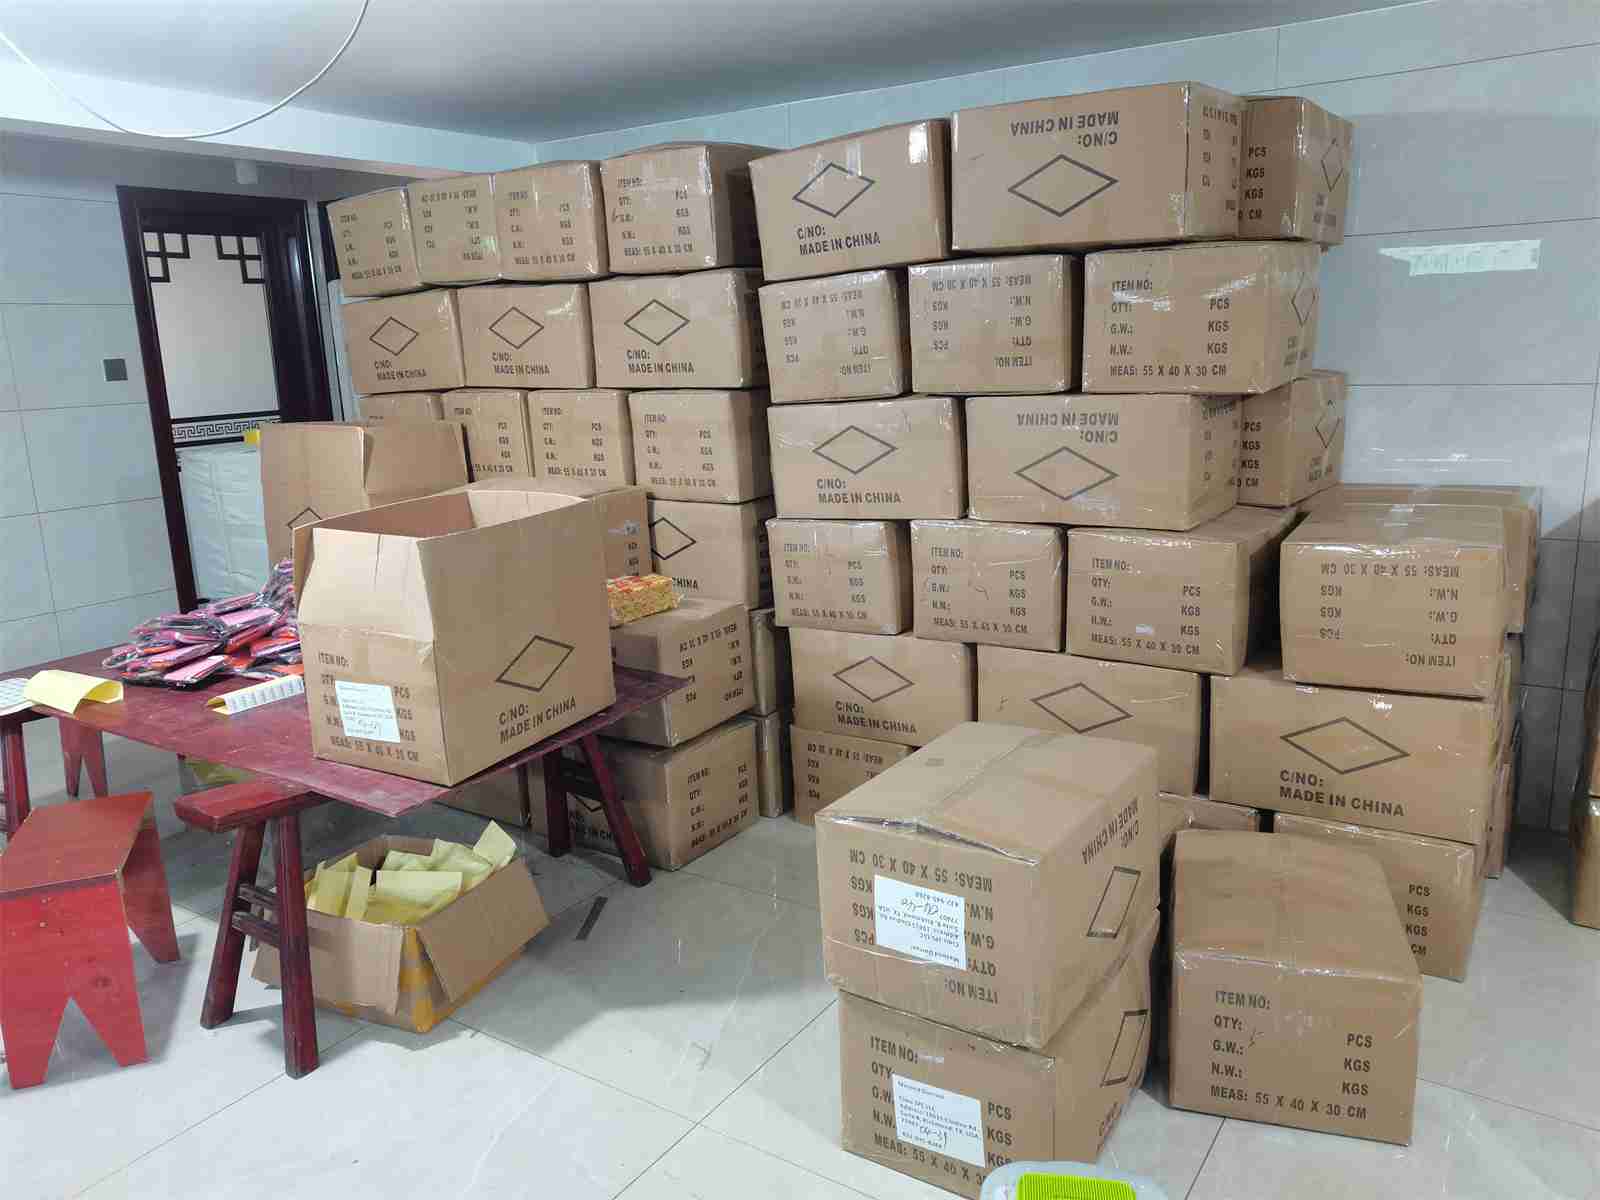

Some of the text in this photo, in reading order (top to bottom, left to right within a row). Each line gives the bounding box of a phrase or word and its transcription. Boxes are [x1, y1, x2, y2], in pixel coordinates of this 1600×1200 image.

[1010, 112, 1119, 136] MADE IN CHINA
[1078, 131, 1118, 147] C/NO:
[1248, 146, 1267, 159] PCS
[1246, 168, 1265, 178] KGS
[1245, 188, 1264, 200] KGS
[1248, 209, 1263, 220] CM
[797, 225, 826, 239] C/NO:
[800, 232, 881, 256] MADE IN CHINA
[1112, 280, 1133, 291] ITEM
[1210, 298, 1230, 310] PCS
[1208, 321, 1230, 332] KGS
[1207, 342, 1228, 354] KGS
[627, 350, 650, 360] C/NO:
[494, 365, 514, 375] MADE
[526, 364, 549, 374] CHINA
[629, 362, 694, 373] MADE IN CHINA
[1143, 365, 1153, 377] 55
[1158, 365, 1164, 376] X
[1168, 365, 1180, 376] 40
[1184, 365, 1191, 376] X
[1196, 365, 1207, 377] 30
[1212, 364, 1227, 376] CM
[1017, 412, 1119, 425] MADE IN CHINA
[1244, 422, 1261, 432] PCS
[1080, 430, 1118, 442] C/NO:
[1242, 440, 1260, 450] KGS
[1241, 460, 1259, 469] KGS
[817, 478, 846, 489] C/NO:
[818, 492, 901, 504] MADE IN CHINA
[1092, 558, 1112, 569] ITEM
[1321, 563, 1459, 578] MEAS: 55 X 40 X 30 CM
[1183, 585, 1200, 597] PCS
[1321, 584, 1342, 596] KGS
[1430, 588, 1458, 600] N.W.:
[1181, 606, 1200, 616] KGS
[1320, 607, 1342, 618] KGS
[1429, 611, 1457, 623] G.W.:
[1180, 625, 1200, 636] KGS
[1320, 627, 1342, 639] PCS
[1431, 633, 1456, 645] QTY:
[1121, 637, 1132, 648] 55
[1145, 640, 1156, 650] 40
[1171, 644, 1182, 654] 30
[1186, 644, 1200, 655] CM
[1406, 654, 1456, 667] ITEM NO:
[499, 704, 529, 725] C/NO:
[500, 696, 576, 744] MADE IN CHINA
[838, 715, 917, 734] MADE IN CHINA
[1280, 769, 1324, 787] C/NO:
[1280, 786, 1405, 817] MADE IN CHINA
[1081, 829, 1108, 864] CHINA
[850, 848, 993, 892] MEAS: 55 X 40 X 30 CM
[850, 875, 873, 893] KGS
[1409, 884, 1431, 896] PCS
[852, 902, 874, 920] KGS
[1408, 904, 1429, 917] KGS
[854, 928, 874, 945] PCS
[1406, 923, 1428, 937] KGS
[1411, 944, 1427, 955] CM
[967, 958, 996, 977] QTY:
[944, 978, 998, 1005] ITEM NO:
[1216, 990, 1271, 1010] ITEM NO:
[1214, 1015, 1243, 1031] QTY:
[1213, 1040, 1244, 1055] G.W.:
[1347, 1033, 1373, 1049] PCS
[870, 1036, 918, 1064] ITEM NO:
[1211, 1062, 1243, 1079] N.W.:
[1344, 1057, 1371, 1073] KGS
[1342, 1081, 1369, 1096] KGS
[872, 1086, 894, 1105] G.W.
[1210, 1085, 1367, 1120] MEAS: 55 X 40 X 30 CM
[988, 1102, 1012, 1120] PCS
[873, 1109, 895, 1129] N.W.
[987, 1127, 1013, 1145] KGS
[912, 1148, 925, 1163] 55
[931, 1155, 938, 1168] X
[943, 1161, 957, 1175] 40
[961, 1167, 969, 1181] X
